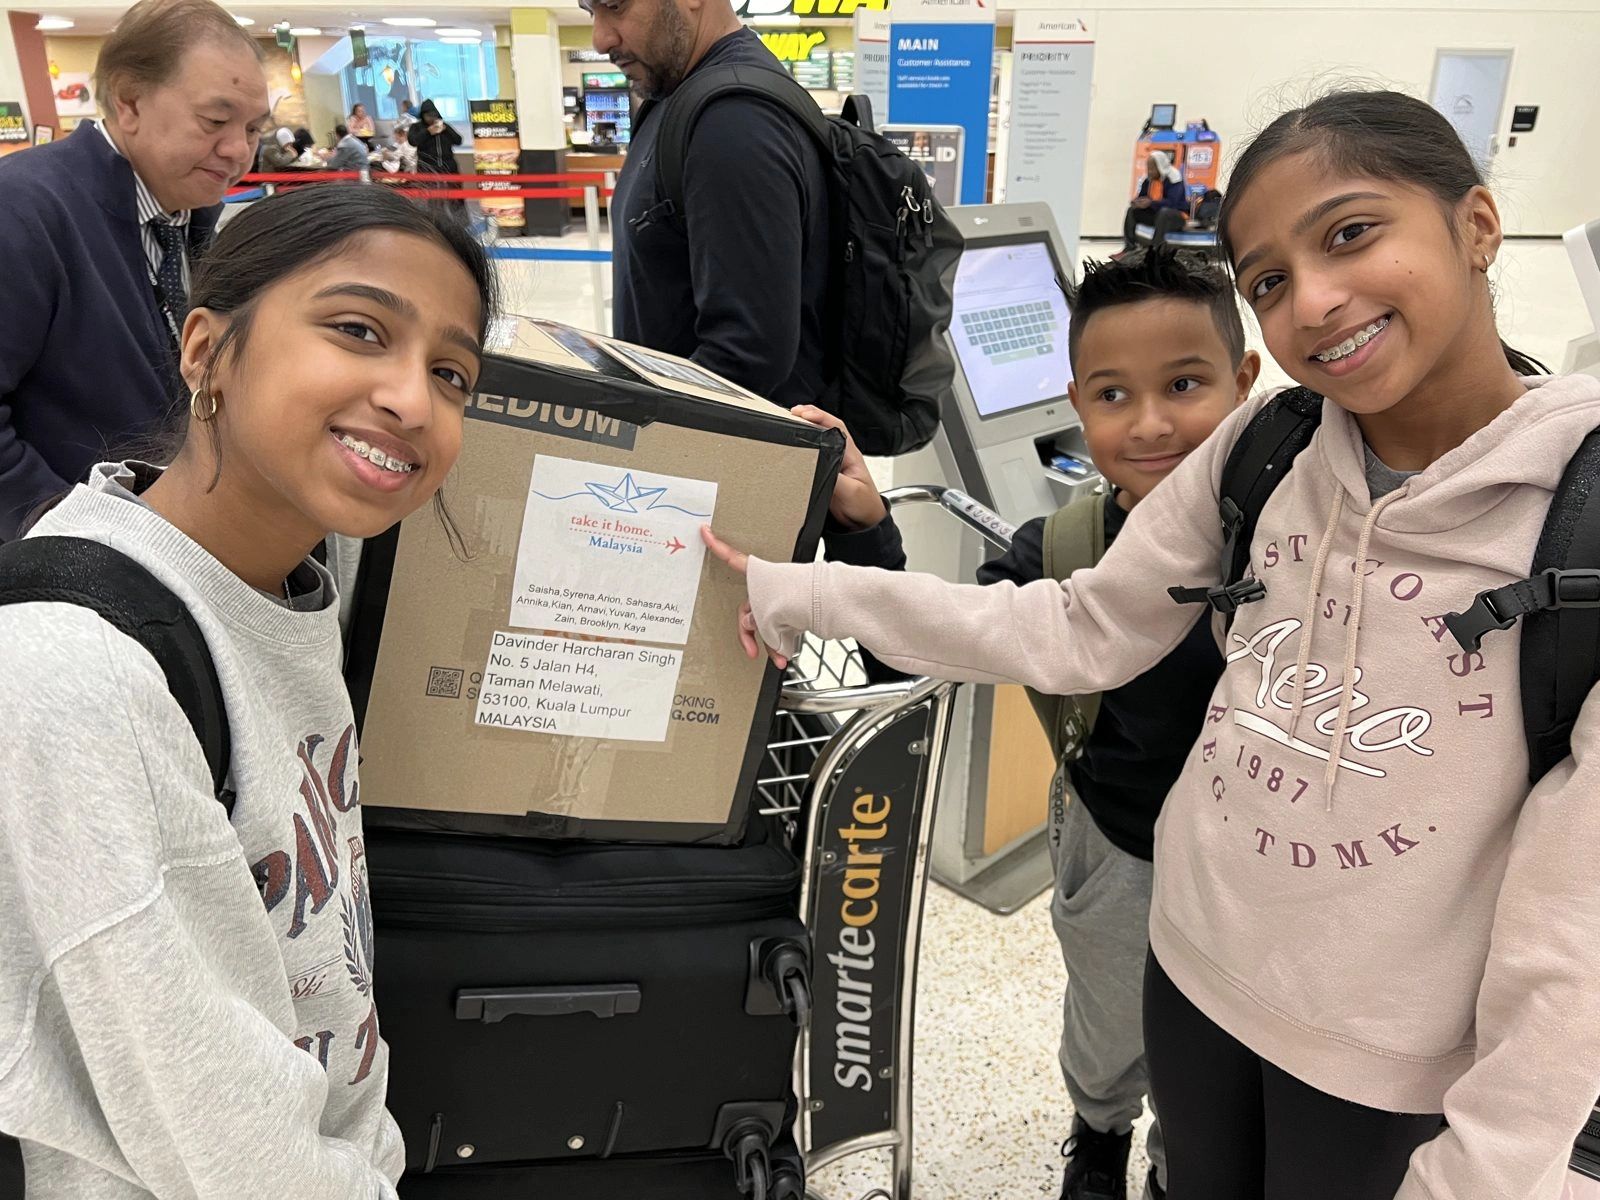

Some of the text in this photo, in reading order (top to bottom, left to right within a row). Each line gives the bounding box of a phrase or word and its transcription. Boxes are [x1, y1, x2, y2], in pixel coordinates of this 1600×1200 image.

[759, 31, 826, 62] WAY
[898, 38, 939, 51] MAIN
[897, 58, 971, 67] Customer Assistance
[1020, 52, 1071, 62] PRIORITY
[936, 146, 957, 162] ID
[570, 514, 653, 537] take it home.
[588, 536, 643, 554] Malaysia
[554, 613, 646, 633] Zain, Brooklyn, Kaya
[640, 612, 685, 626] Alexander,
[493, 633, 559, 652] Davinder
[562, 641, 634, 662] Harcharan
[638, 650, 676, 668] Singh
[490, 653, 598, 677] No. 5 Jalan H4,
[487, 673, 535, 690] Taman
[538, 678, 603, 697] Melawati,
[482, 692, 531, 709] 53100,
[536, 697, 576, 713] Kuala
[580, 702, 632, 718] Lumpur
[673, 694, 716, 710] CKING
[478, 711, 557, 730] MALAYSIA
[671, 709, 720, 724] G.COM
[1235, 744, 1311, 804] 1987
[834, 792, 891, 1091] smartecarte
